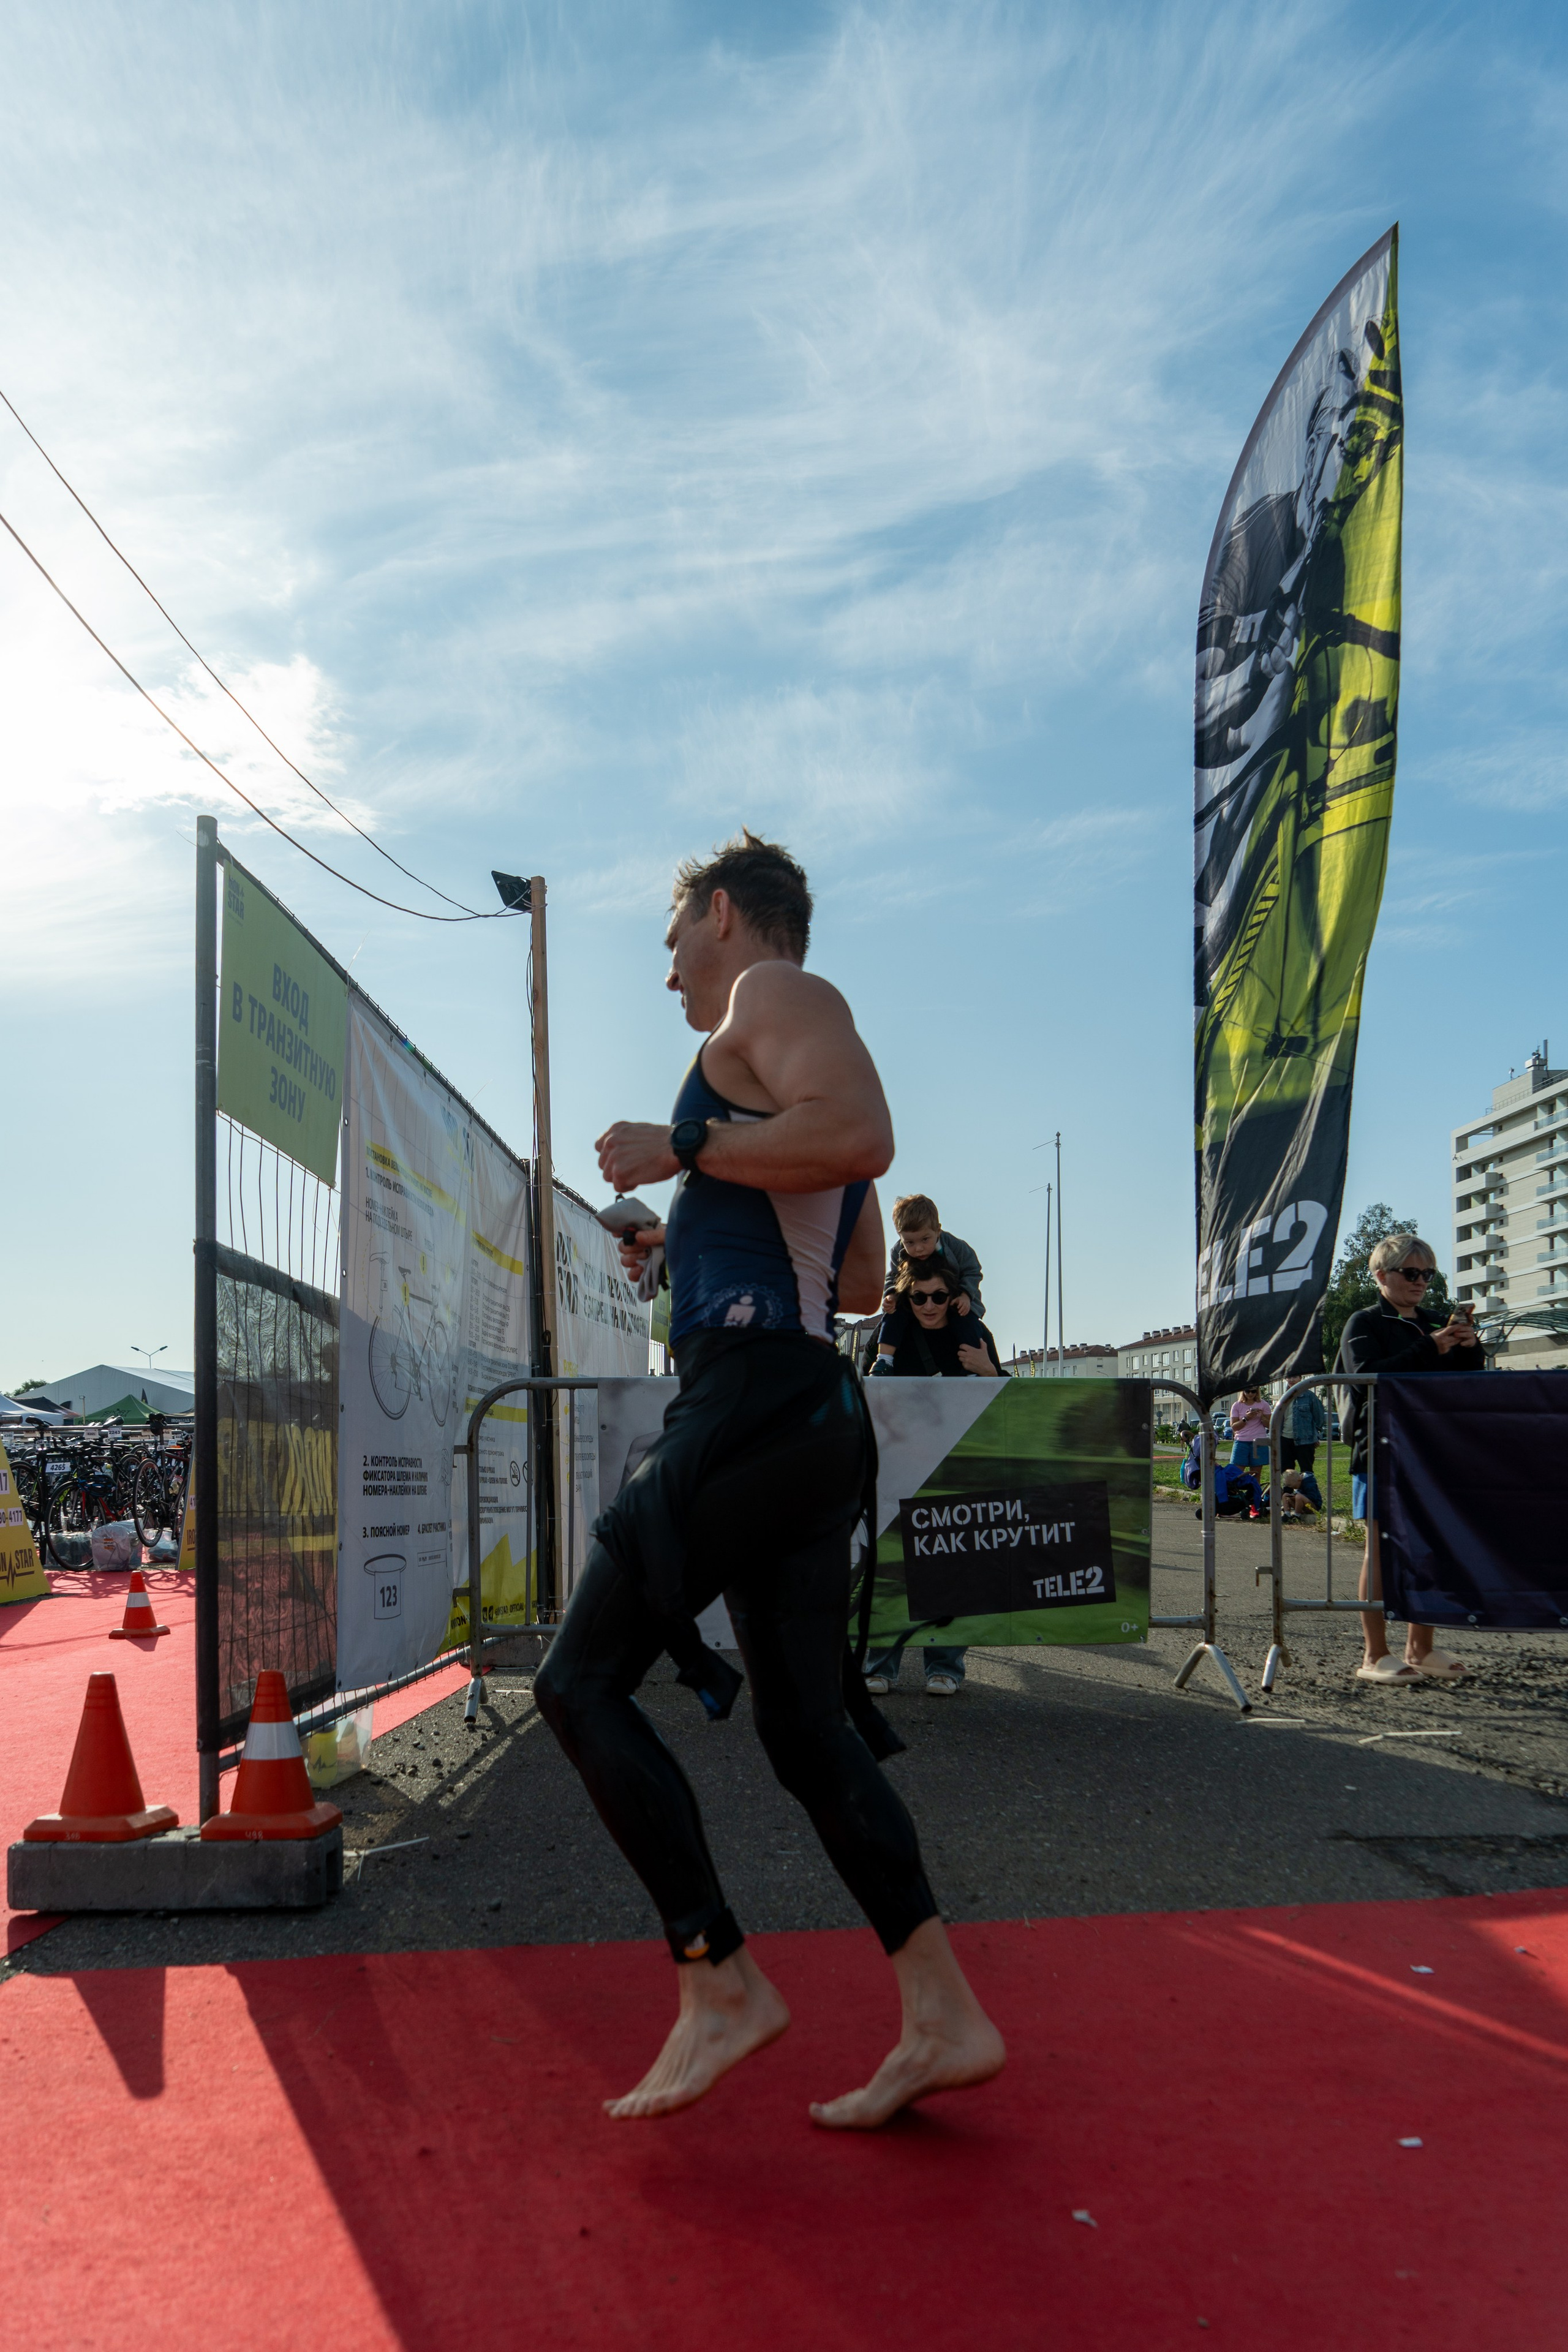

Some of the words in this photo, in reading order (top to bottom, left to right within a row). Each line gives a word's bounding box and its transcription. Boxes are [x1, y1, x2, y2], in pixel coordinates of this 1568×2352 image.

[228, 890, 244, 920] STAR
[273, 963, 309, 1036] ВХОД
[232, 981, 243, 1023] В
[248, 993, 336, 1101] ТРАНЗИТНУЮ
[270, 1066, 306, 1123] ЗОНУ
[366, 1167, 369, 1178] 1.
[370, 1169, 391, 1190] КОНТРОЛЬ
[366, 1210, 372, 1224] НА
[1197, 1200, 1328, 1313] ELE2
[363, 1455, 369, 1466] 2.
[371, 1455, 398, 1467] КОНТРОЛЬ
[398, 1457, 423, 1468] ИСПРАВНОСТИ
[363, 1470, 396, 1481] ФИКСАТОРА
[396, 1471, 411, 1482] ШЛЕМА
[363, 1482, 411, 1496] НОМЕРА-НАКЛЕЙКИ
[412, 1485, 417, 1495] НА
[911, 1499, 1030, 1529] СМОТРИ,
[187, 1529, 195, 1545] IRO
[363, 1526, 369, 1538] 3.
[371, 1523, 396, 1538] ПОЯСНОЙ
[397, 1525, 410, 1536] НОМЕР
[418, 1524, 421, 1534] 4.
[914, 1532, 967, 1556] КАК
[974, 1521, 1076, 1551] КРУТИТ
[15, 1548, 34, 1571] STAR
[1033, 1566, 1105, 1599] TELE2
[380, 1585, 398, 1608] 123
[1121, 1622, 1139, 1633] 0+
